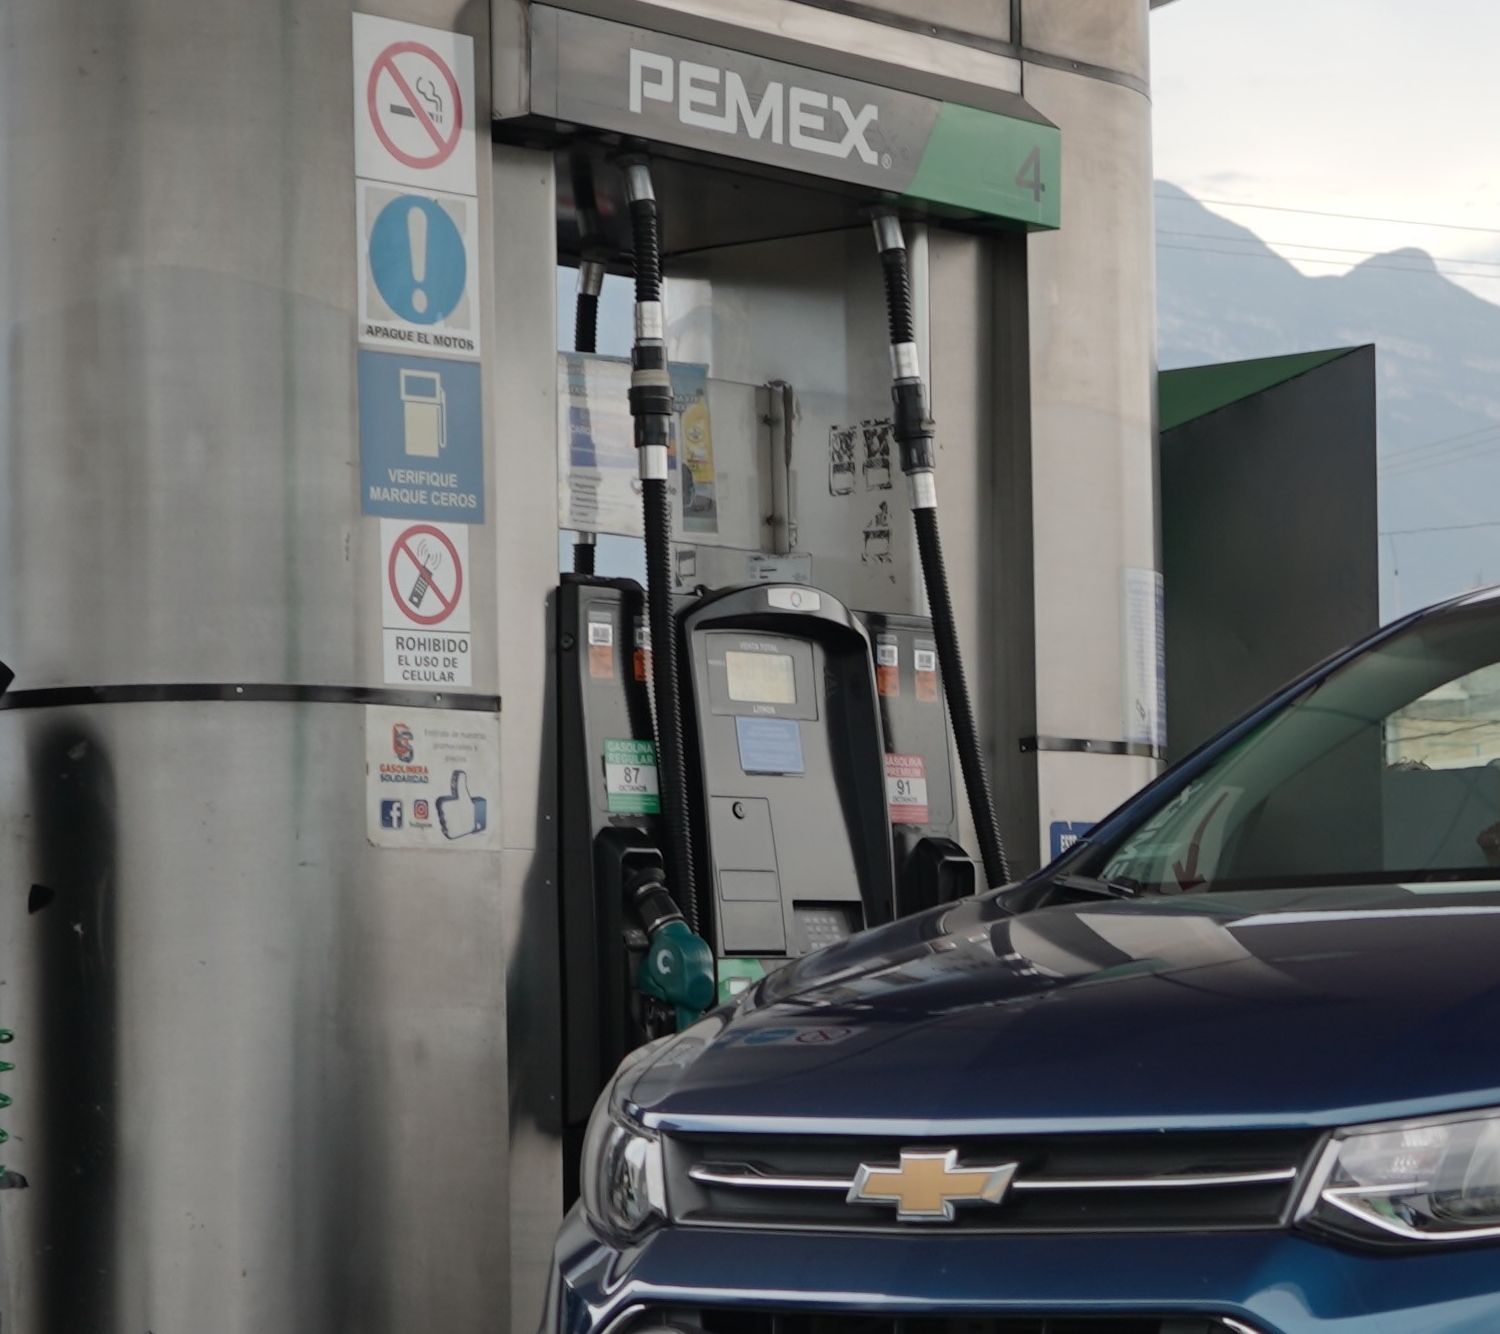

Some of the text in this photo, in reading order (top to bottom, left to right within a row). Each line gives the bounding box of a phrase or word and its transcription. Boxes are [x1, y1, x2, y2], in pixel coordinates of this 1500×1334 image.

[628, 48, 878, 165] PEMEX
[1014, 146, 1045, 203] 4
[365, 324, 414, 343] APAGUE
[416, 331, 431, 345] EL
[387, 468, 458, 488] VERIFIQUE
[369, 485, 477, 508] MARQUE CEROS
[395, 635, 469, 654] ROHIBIDO
[397, 655, 459, 669] EL USO DE
[402, 669, 455, 684] CELULAR
[623, 767, 640, 784] 87
[896, 779, 912, 796] 91
